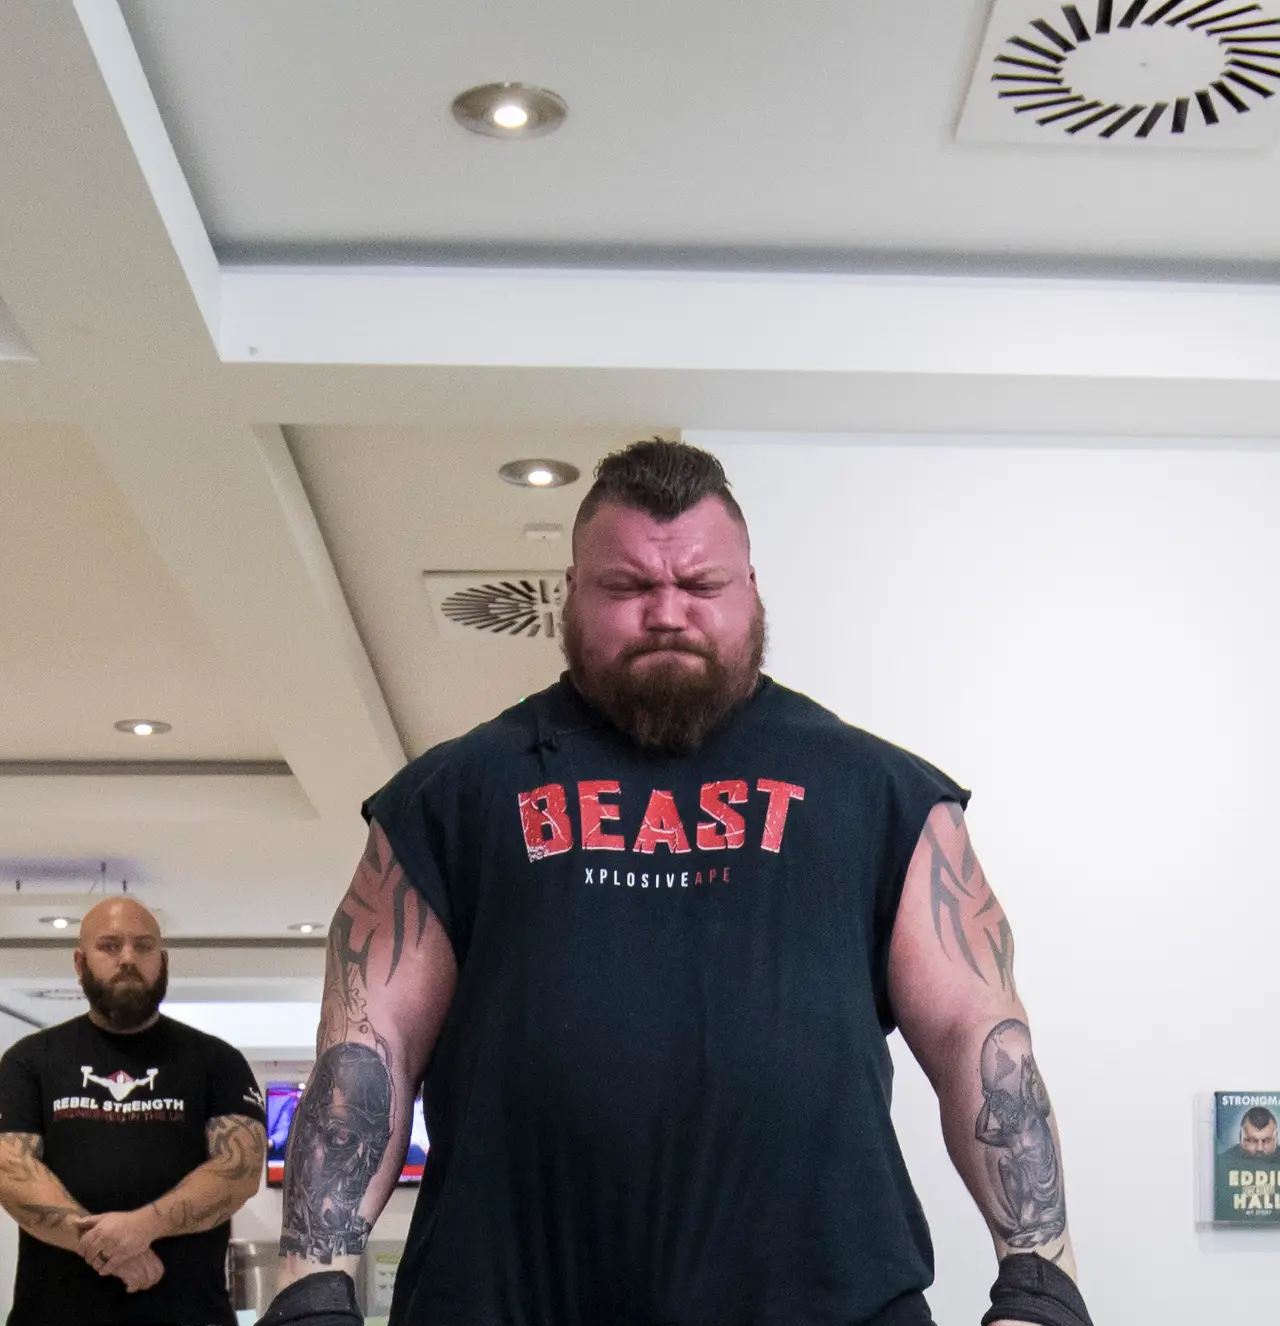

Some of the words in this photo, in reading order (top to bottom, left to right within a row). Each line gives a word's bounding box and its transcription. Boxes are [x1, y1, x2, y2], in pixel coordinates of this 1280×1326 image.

[518, 778, 805, 863] BEAST
[53, 1096, 98, 1111] REBEL
[102, 1098, 184, 1113] STRENGTH
